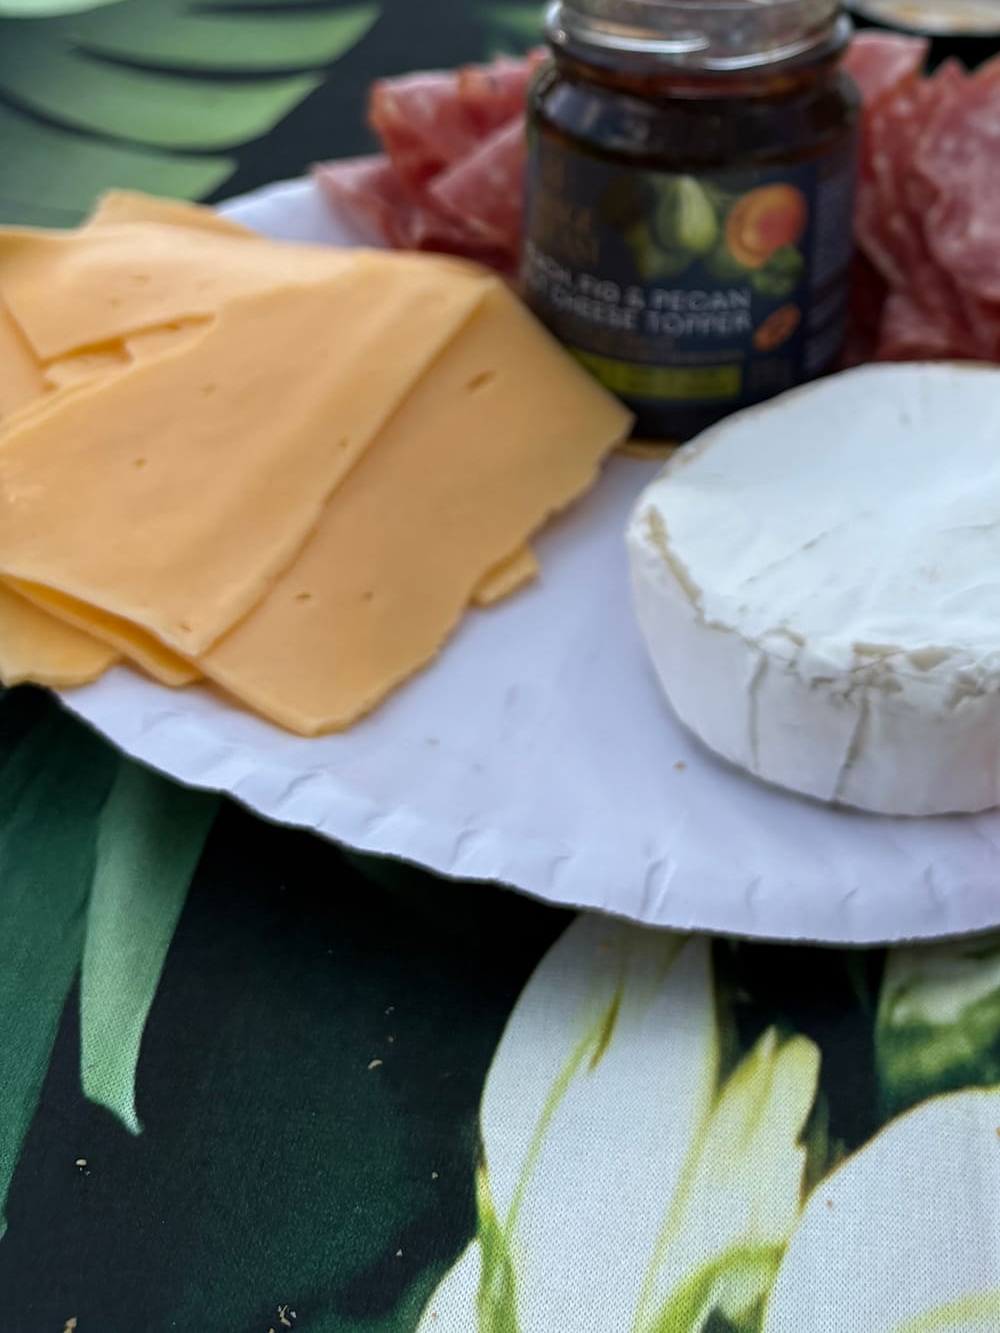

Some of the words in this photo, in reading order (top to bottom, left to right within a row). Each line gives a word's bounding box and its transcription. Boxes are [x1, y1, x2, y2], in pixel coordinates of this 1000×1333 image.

[550, 282, 639, 331] CHEESE
[643, 309, 752, 338] TOPPER
[623, 285, 646, 310] &
[648, 288, 752, 312] PECAN
